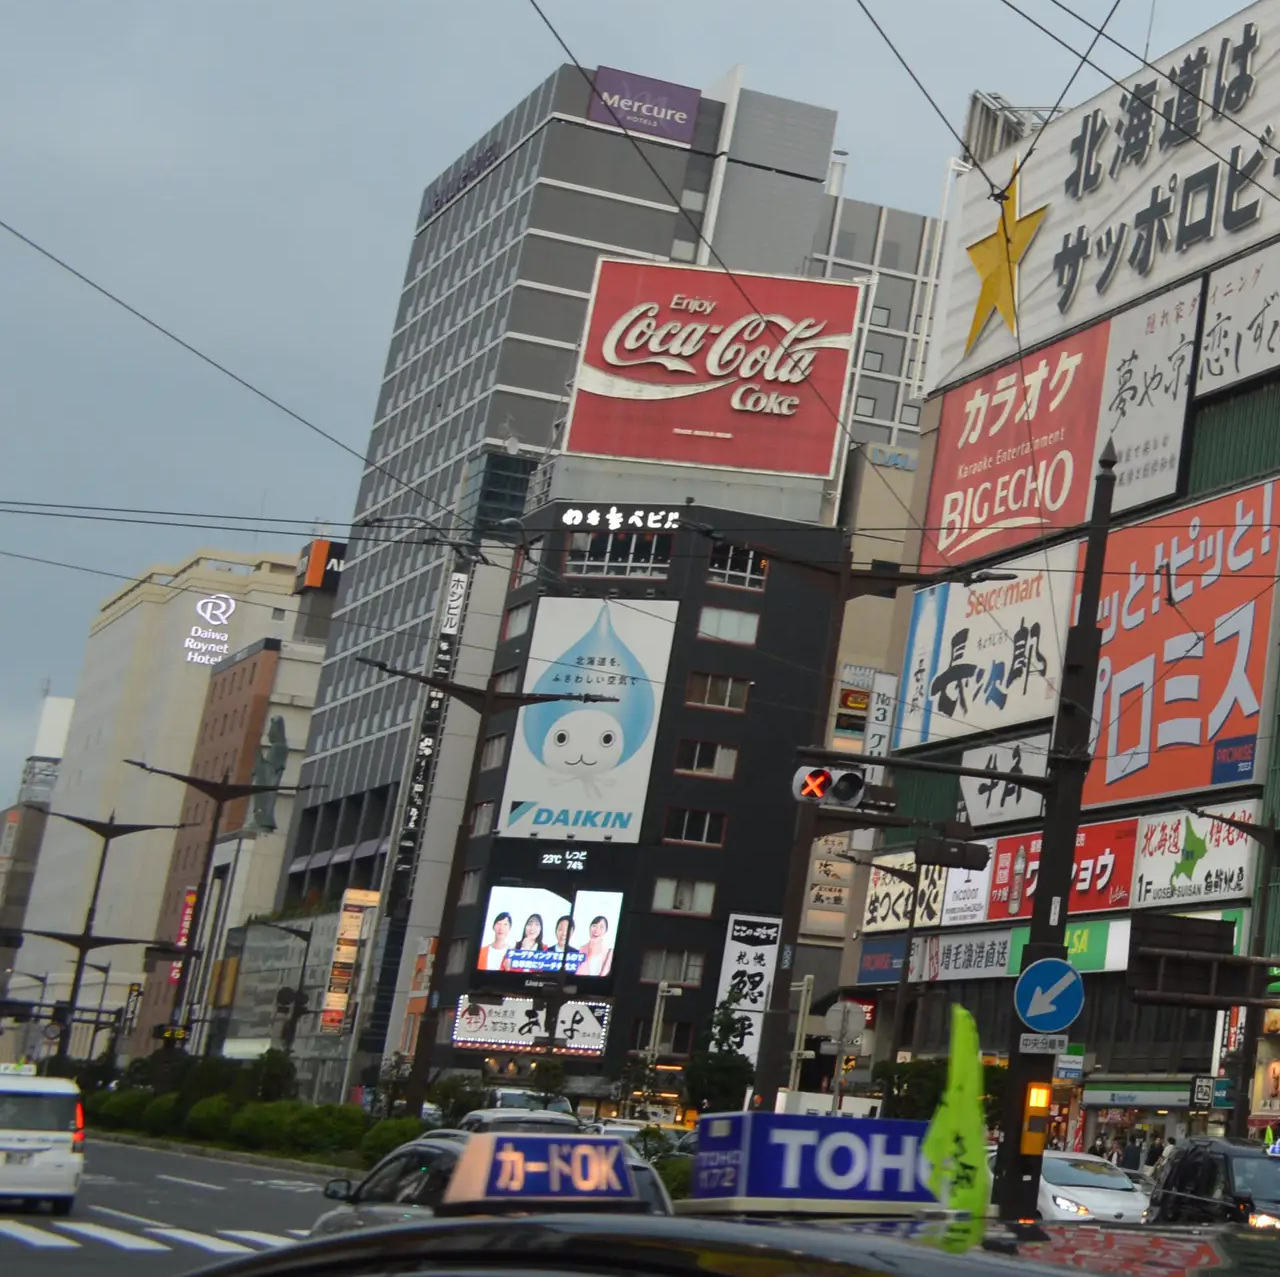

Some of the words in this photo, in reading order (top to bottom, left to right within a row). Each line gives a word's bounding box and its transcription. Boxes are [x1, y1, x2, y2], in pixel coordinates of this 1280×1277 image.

[600, 91, 688, 124] Mercure
[1064, 21, 1261, 200] 北海道は
[669, 293, 718, 315] Enjoy
[601, 299, 828, 384] Coca-Cola
[730, 382, 800, 416] Coke
[957, 351, 1083, 450] カラオケ
[957, 456, 993, 480] Karaoke
[996, 426, 1066, 464] Entertainment
[937, 482, 993, 554] BIG
[993, 449, 1075, 515] ECHO
[1074, 482, 1274, 646] ッと!ピッと!
[184, 637, 229, 654] Roynet
[190, 626, 229, 641] Daiwa
[186, 651, 222, 665] Hotel
[928, 615, 1048, 718] 長次郎
[552, 675, 639, 686] ふさわしい空気で
[532, 807, 634, 830] DAIKIN
[1141, 818, 1182, 859] 北海道
[1137, 873, 1153, 903] 1F
[735, 950, 767, 968] 札幌
[495, 1141, 623, 1193] カードOK
